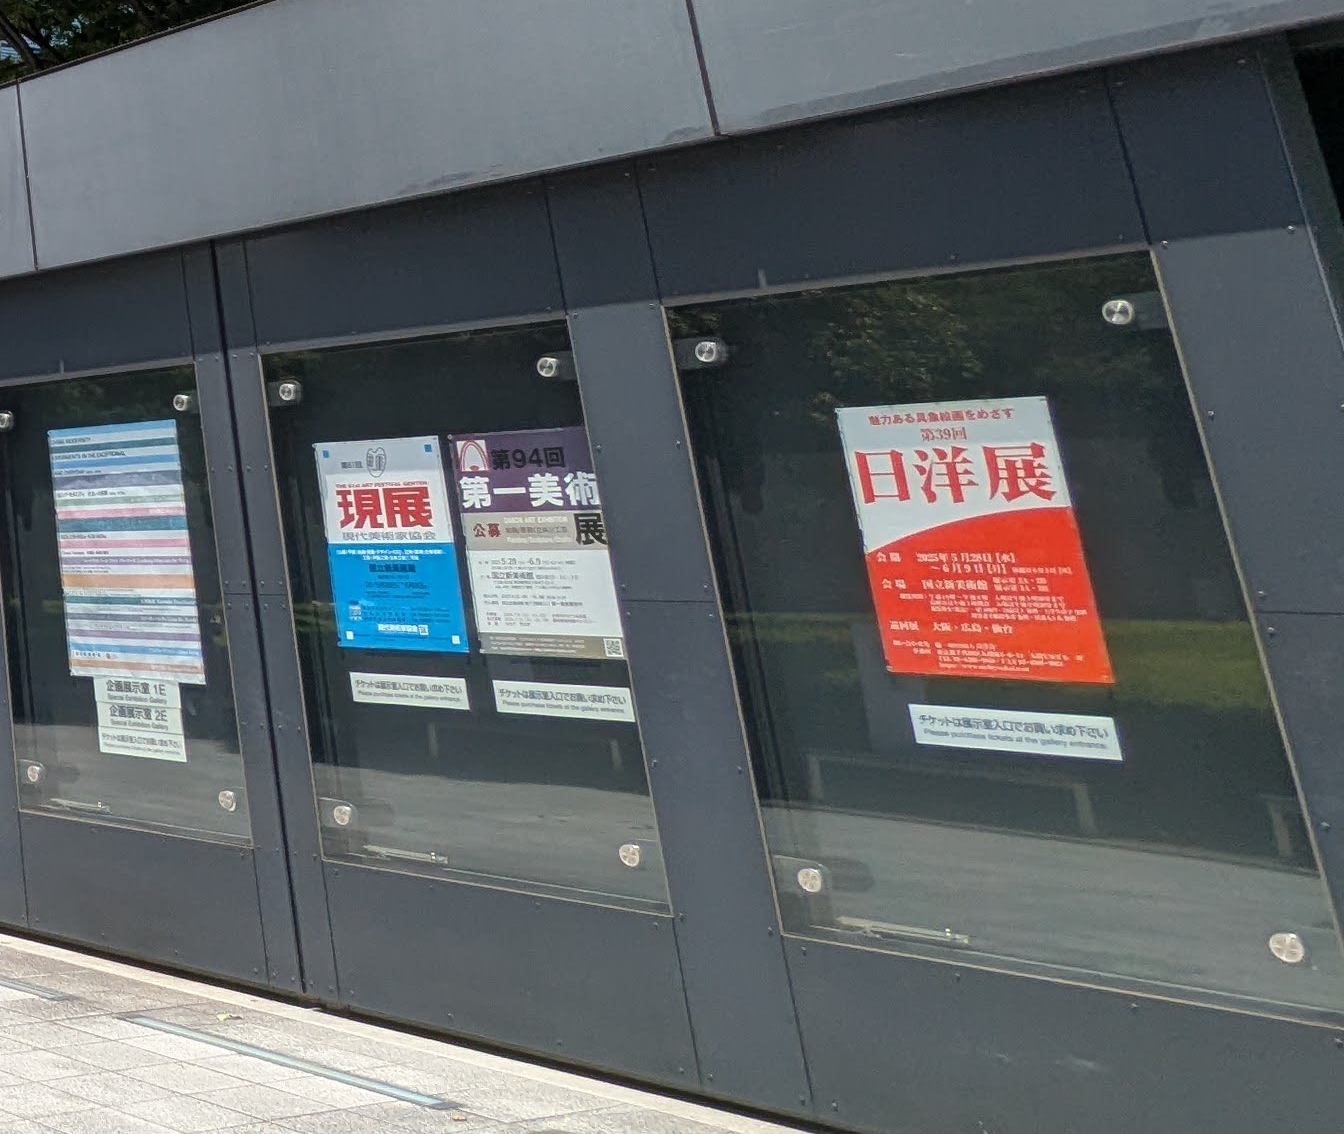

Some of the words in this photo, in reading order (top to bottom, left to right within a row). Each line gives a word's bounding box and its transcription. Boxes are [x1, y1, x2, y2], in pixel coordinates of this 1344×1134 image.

[868, 408, 1015, 426] 魅力ある具象絵画をめざす
[920, 426, 968, 442] 第39回
[490, 446, 566, 470] 第94回
[854, 442, 1057, 504] 日洋展
[459, 471, 602, 509] 第一美術
[336, 486, 434, 529] 現展
[473, 523, 502, 538] 公募
[573, 512, 609, 546] 展
[106, 679, 150, 695] 企画展示室
[109, 704, 152, 721] 企画展示室
[154, 708, 168, 722] 2E
[1024, 735, 1038, 744] the
